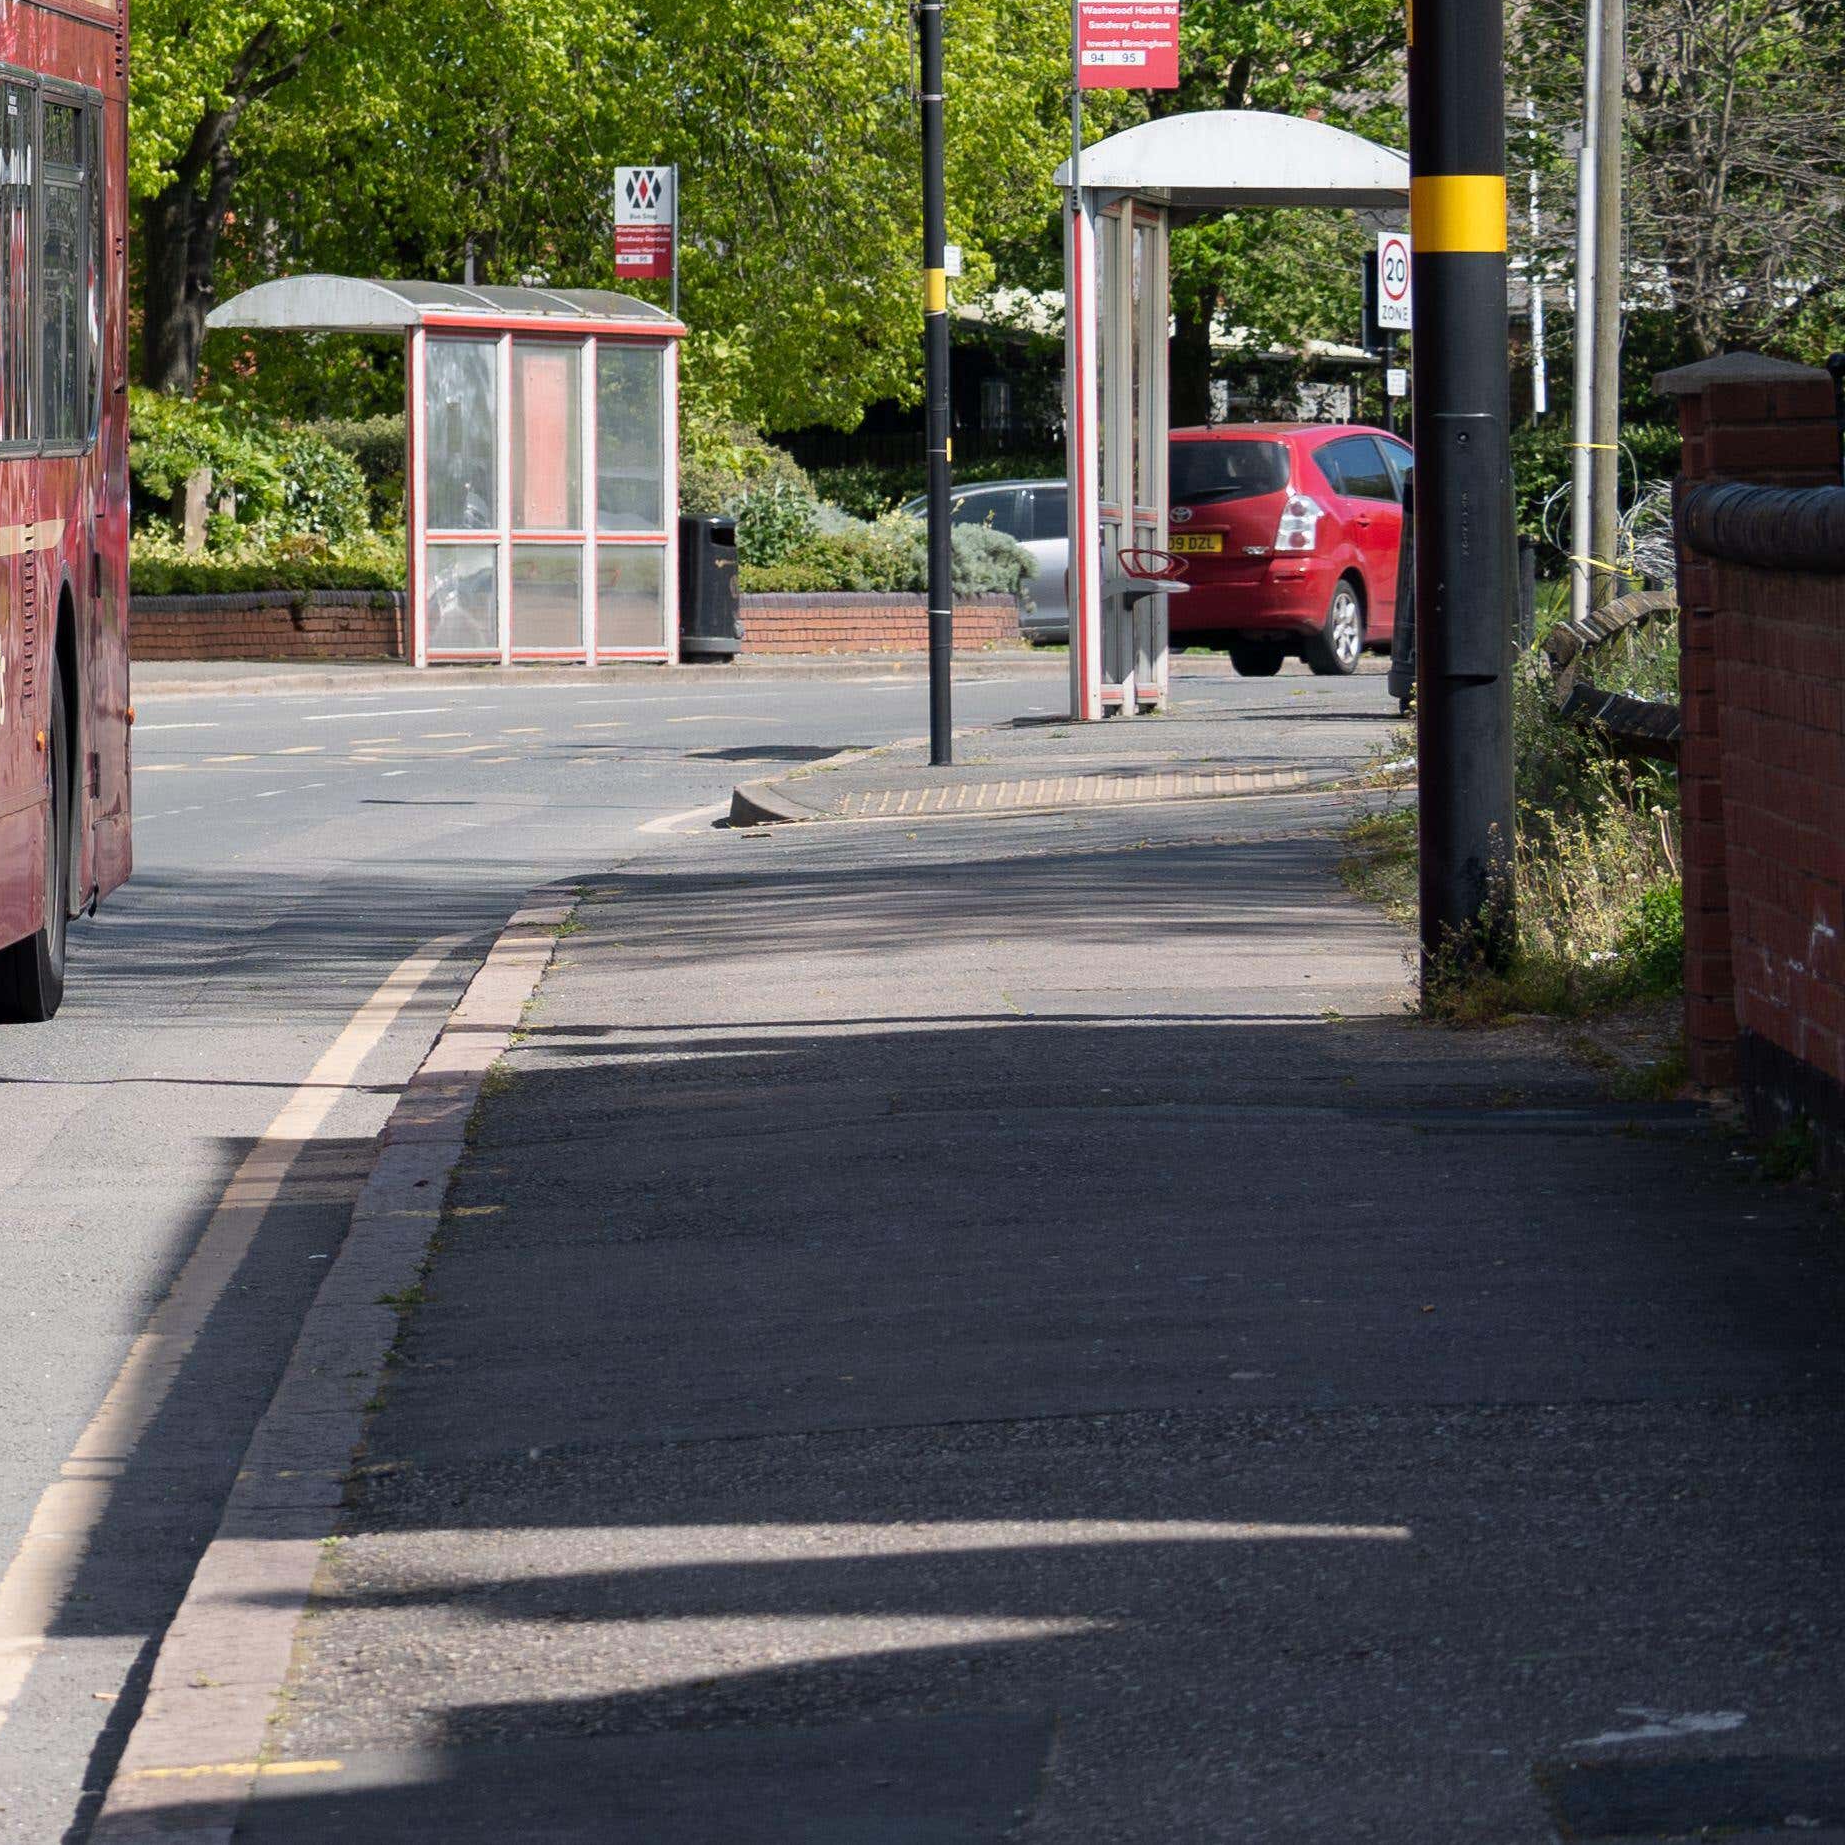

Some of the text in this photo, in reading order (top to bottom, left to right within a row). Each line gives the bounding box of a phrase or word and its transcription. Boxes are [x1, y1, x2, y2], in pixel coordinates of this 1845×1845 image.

[1090, 52, 1137, 63] 94 95
[1386, 257, 1405, 282] 20
[1382, 305, 1408, 322] ZONE
[1189, 537, 1215, 550] DZL
